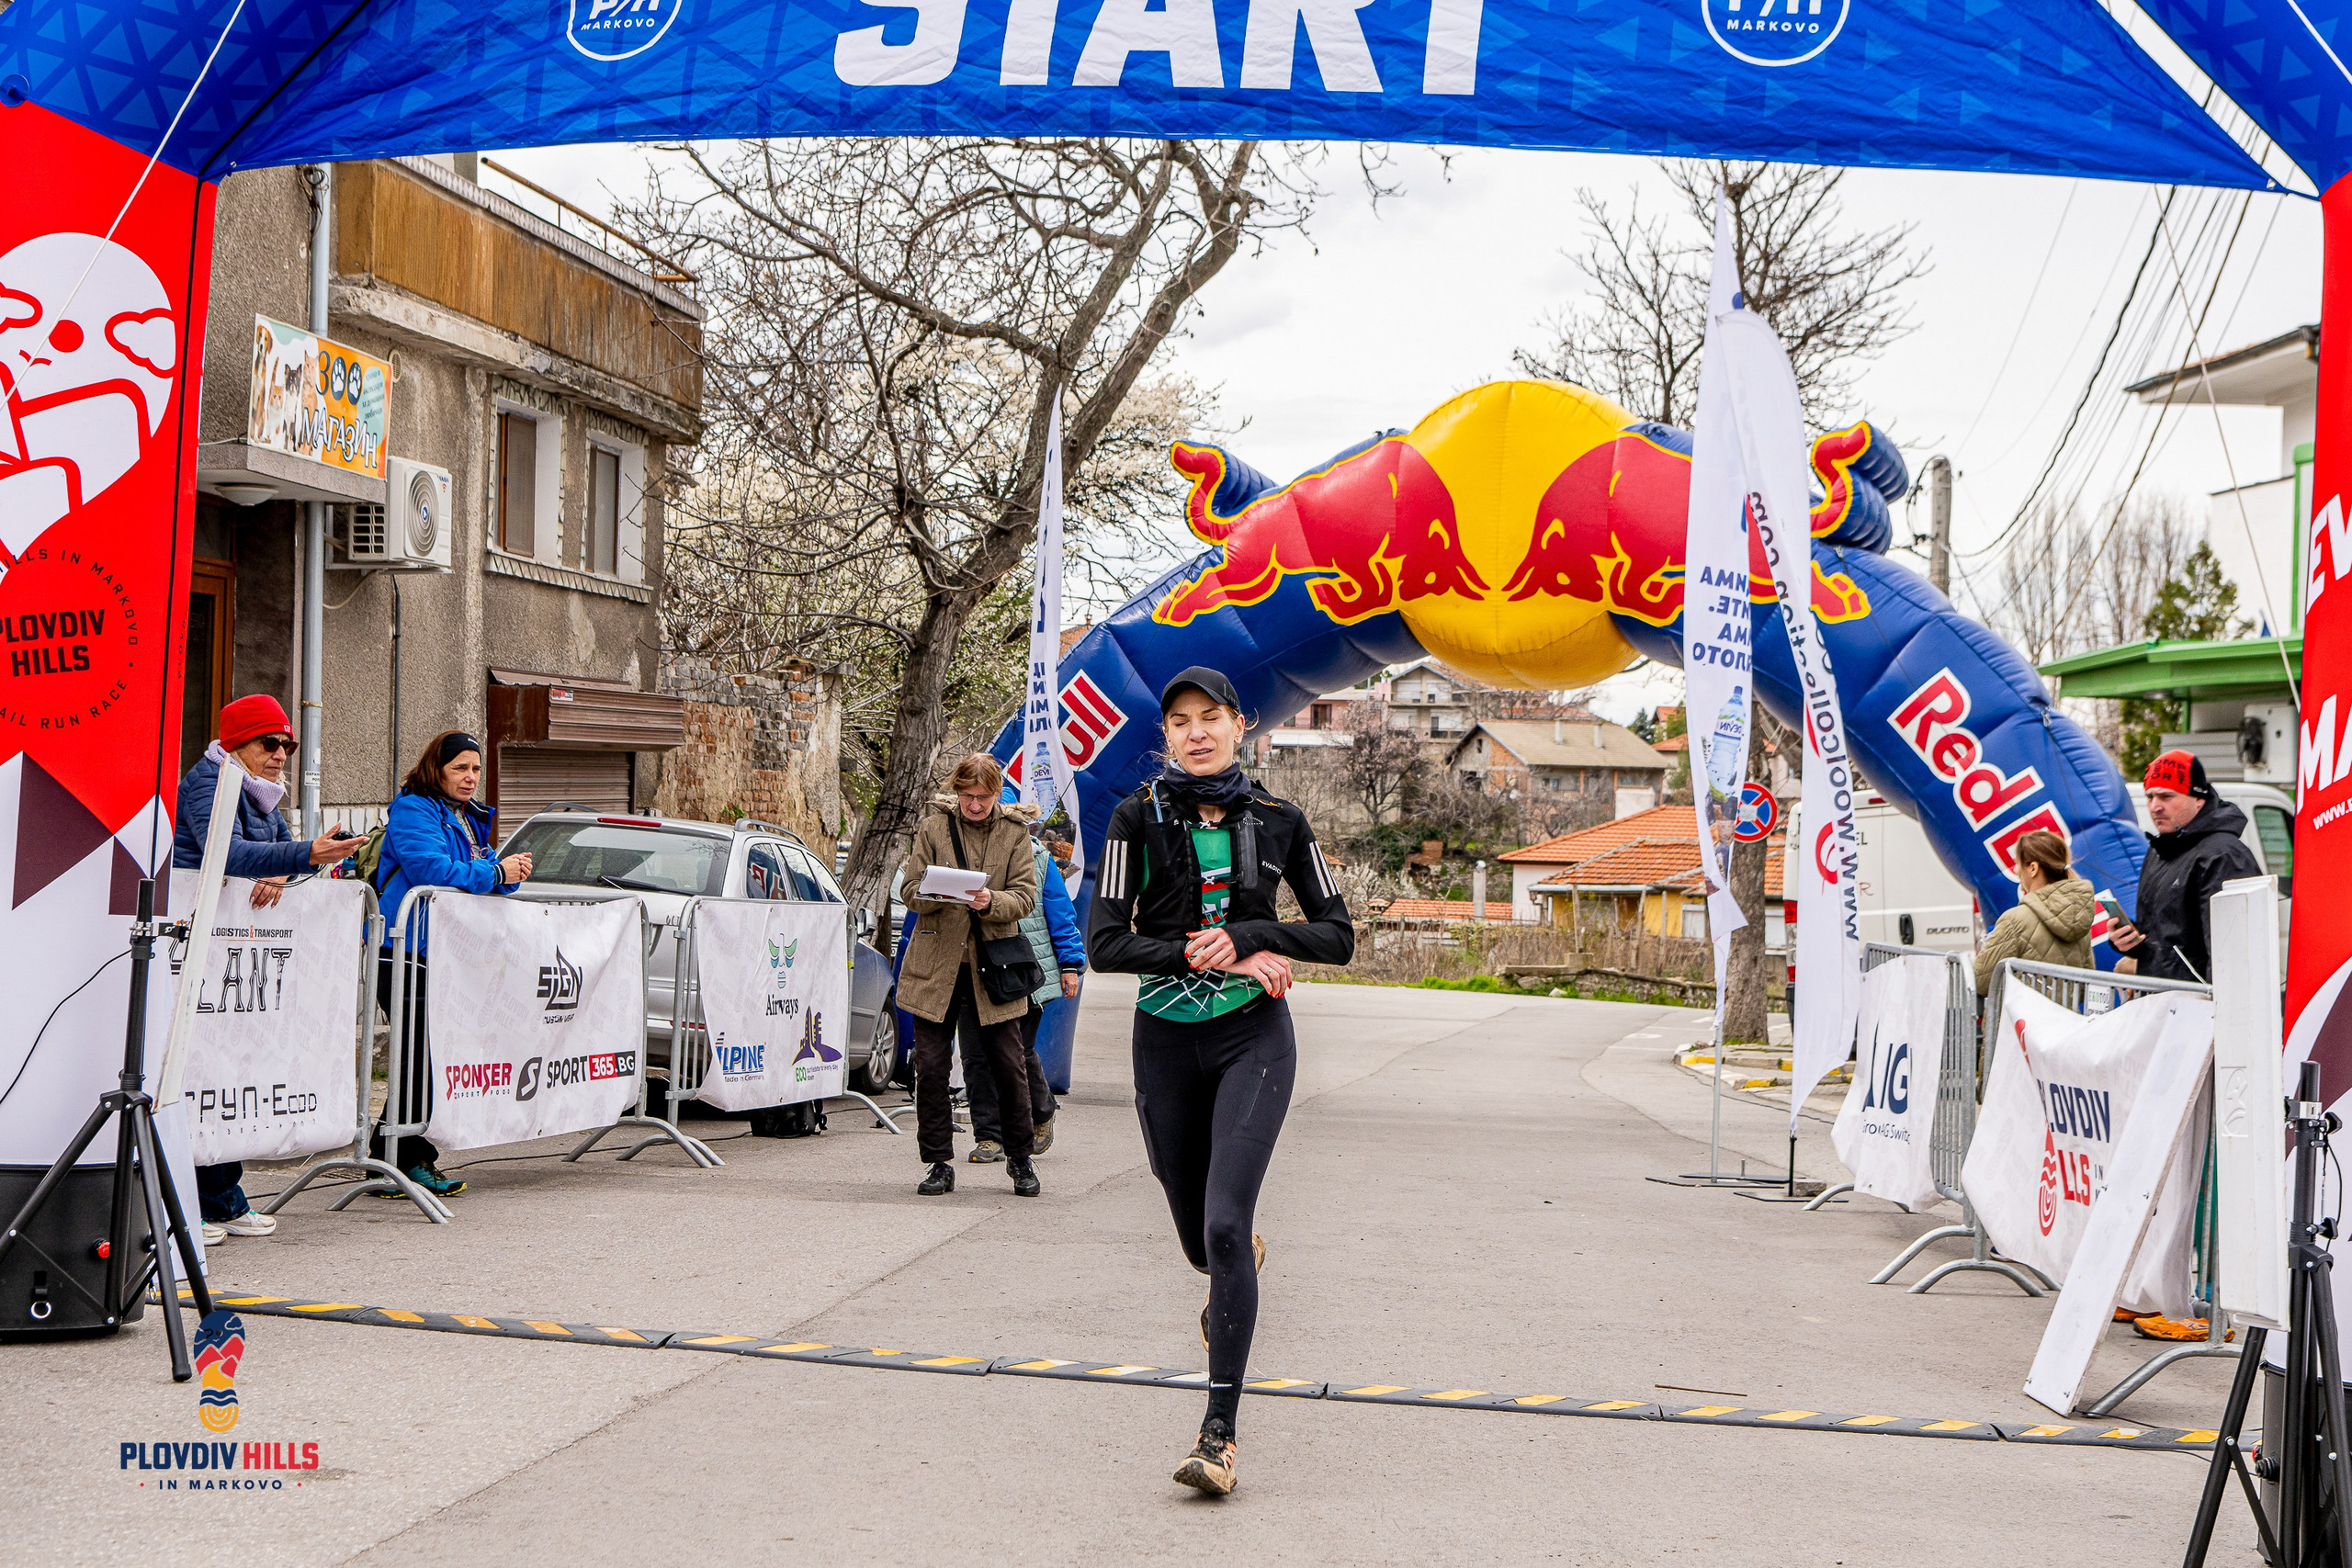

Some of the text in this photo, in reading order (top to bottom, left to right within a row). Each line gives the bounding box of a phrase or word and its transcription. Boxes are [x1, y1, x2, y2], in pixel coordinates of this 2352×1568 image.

[581, 17, 655, 30] MARKOVO
[1726, 18, 1820, 34] MARKOVO
[300, 406, 378, 469] МАГАЗИН
[0, 548, 138, 646] ILLS IN MARKOVO
[0, 608, 106, 644] LOVDIV
[10, 644, 91, 678] HILLS
[40, 714, 80, 729] RUN
[89, 679, 128, 718] RACE
[1894, 674, 2036, 824] Red
[1261, 860, 1283, 875] EVADICT
[1926, 926, 1970, 935] DUCATO
[765, 994, 799, 1020] Airways
[446, 1061, 513, 1101] SPONSER
[795, 1066, 807, 1083] ECO
[490, 1088, 511, 1097] FOOD
